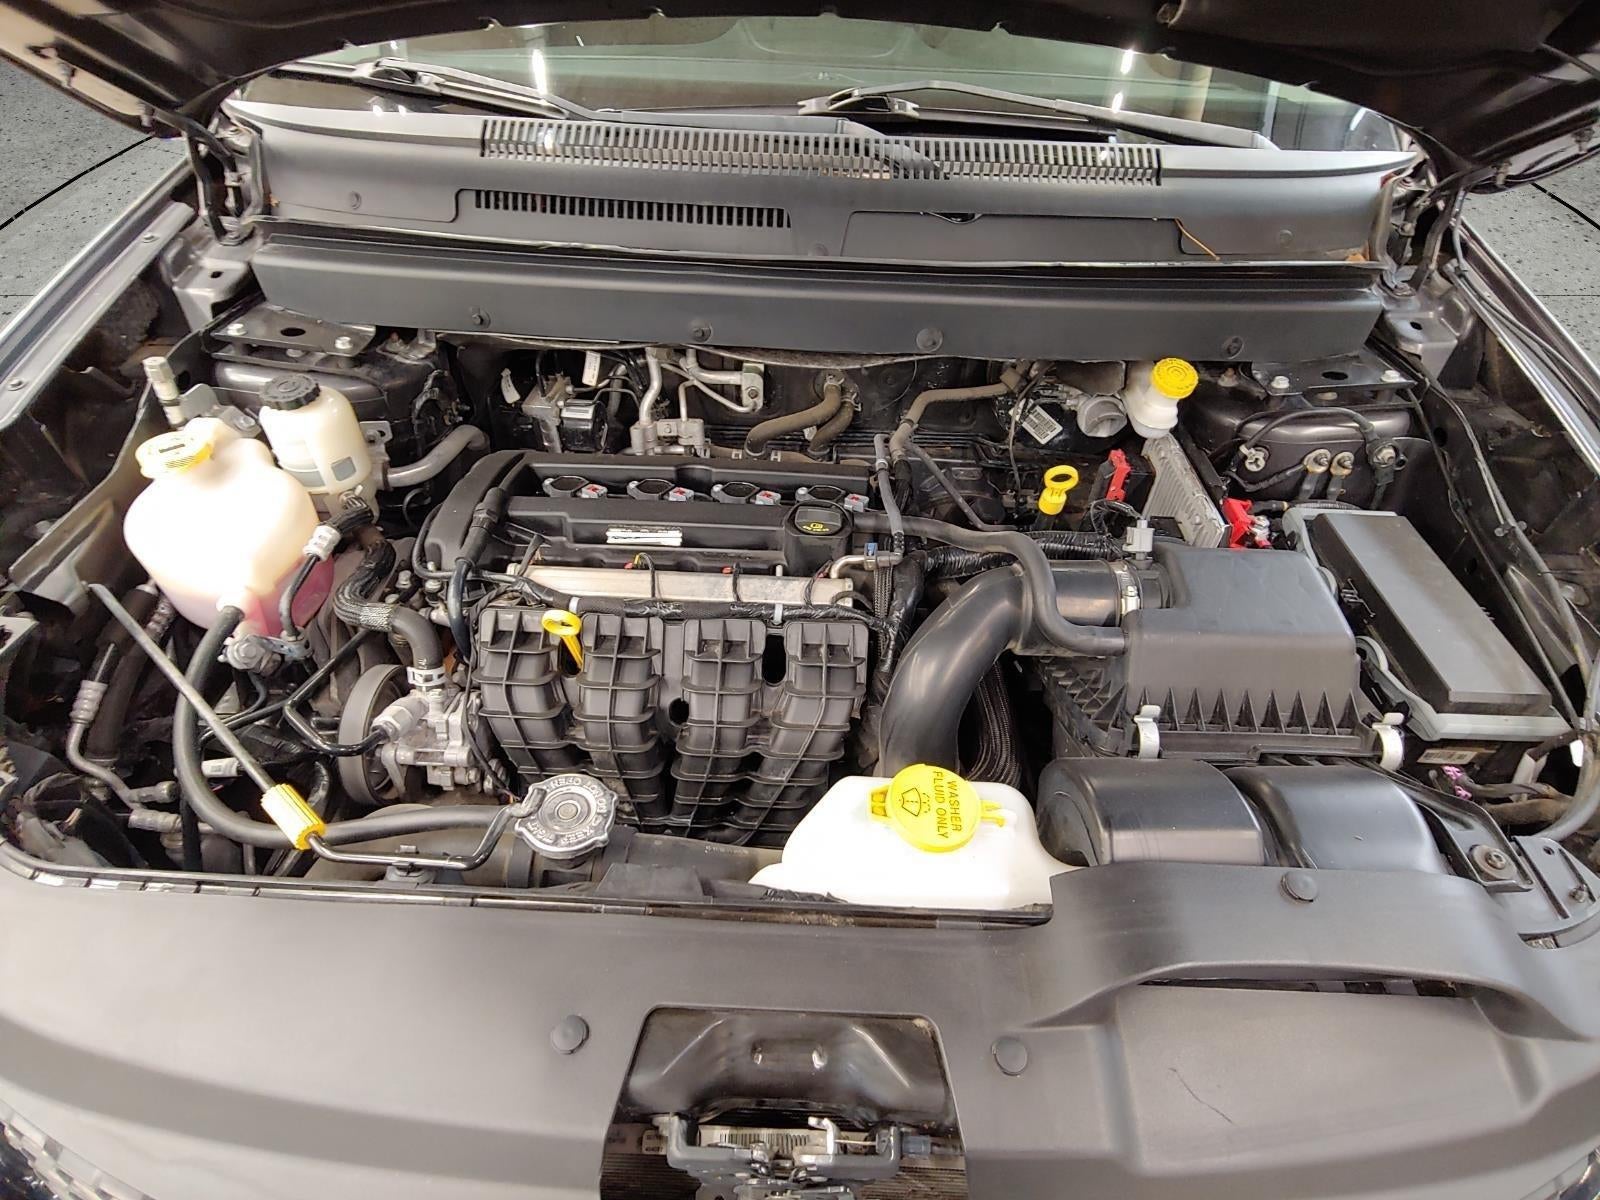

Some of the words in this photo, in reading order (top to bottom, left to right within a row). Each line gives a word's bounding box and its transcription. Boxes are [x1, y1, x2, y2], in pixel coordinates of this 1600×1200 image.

[551, 777, 582, 790] OPEN
[584, 782, 604, 798] NOT
[934, 771, 946, 803] FLUID
[948, 781, 962, 832] WASHER
[936, 808, 949, 838] ONLY
